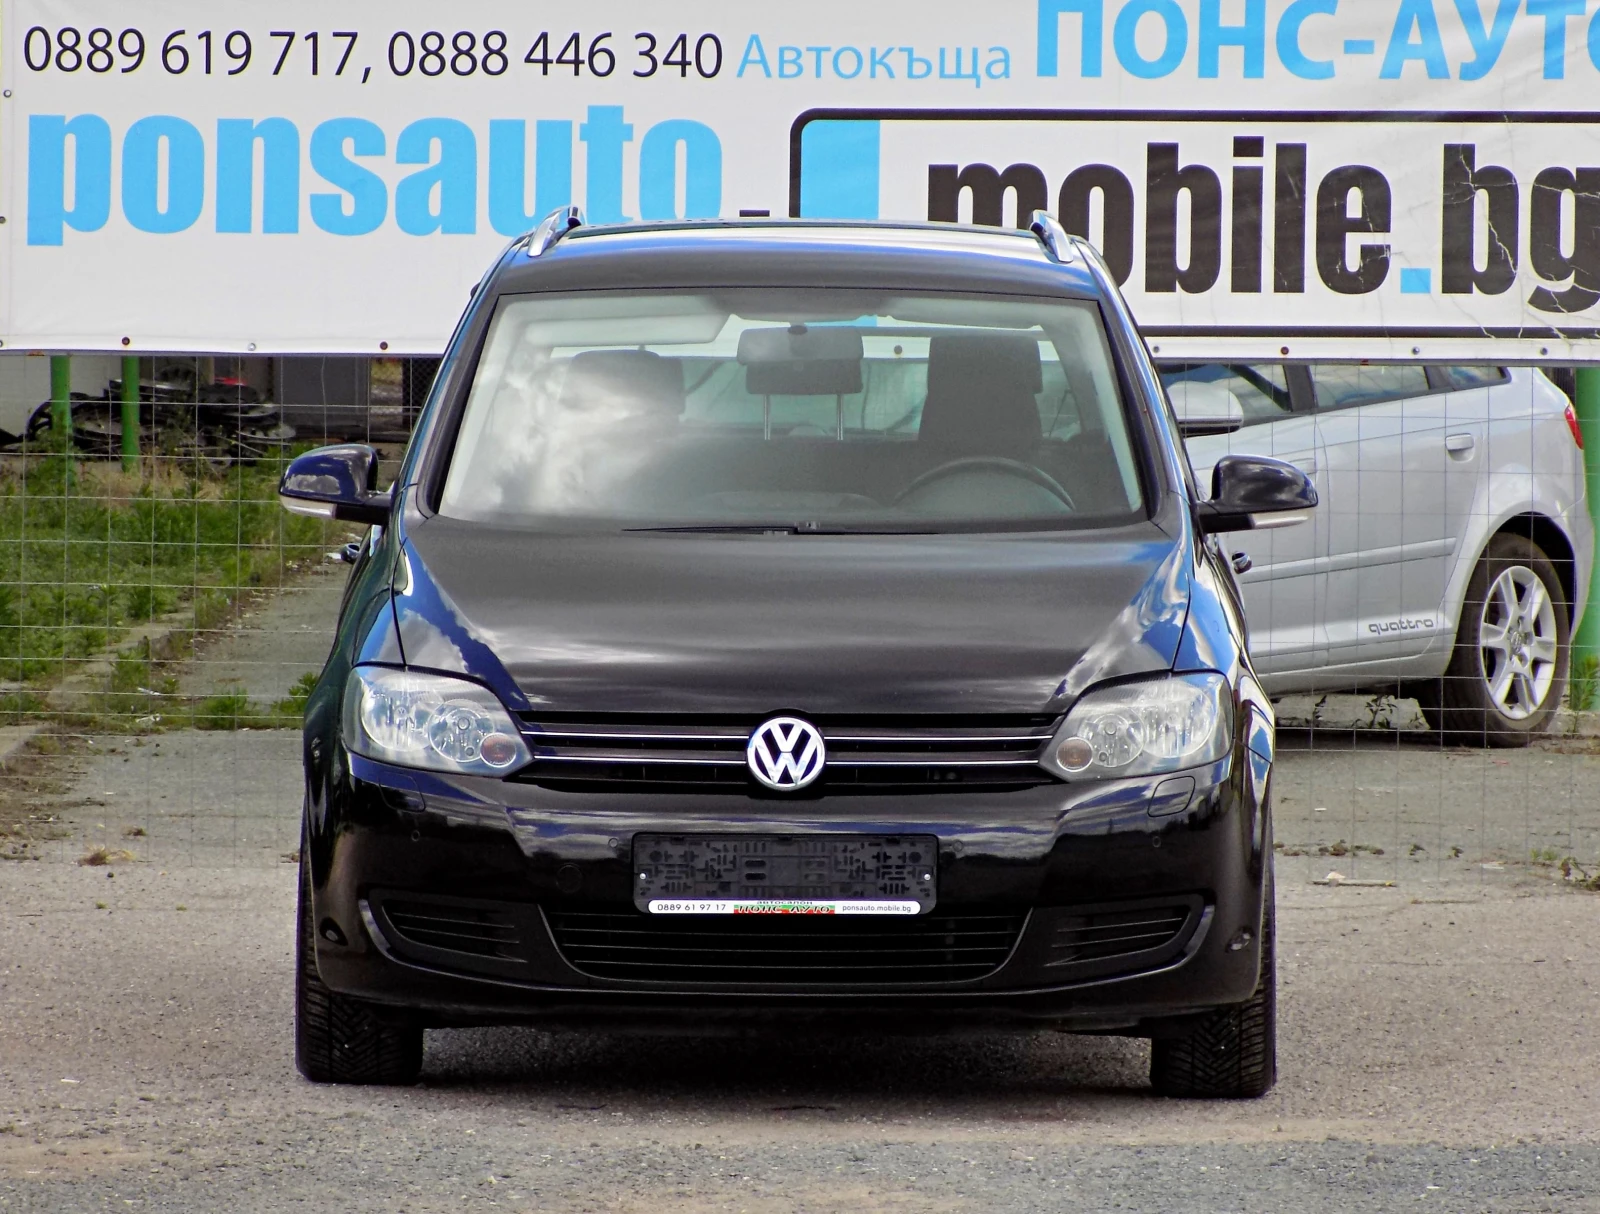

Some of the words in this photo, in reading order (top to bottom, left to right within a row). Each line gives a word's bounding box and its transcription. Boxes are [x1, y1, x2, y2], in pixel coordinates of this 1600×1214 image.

[24, 26, 146, 73] 0889
[161, 30, 252, 75] 619
[269, 31, 372, 84] 717,
[388, 30, 509, 76] 0888
[524, 31, 616, 77] 446
[632, 32, 723, 78] 340
[736, 33, 1011, 89] Автокъща
[1036, 0, 1600, 81] ПОНС-АУТ
[27, 105, 723, 246] ponsauto
[1368, 618, 1434, 635] quattro
[657, 903, 682, 911] 0889
[684, 903, 696, 911] 61
[699, 903, 711, 911] 97
[716, 903, 726, 911] 17
[842, 904, 912, 913] ponsauto.mobile.bg
